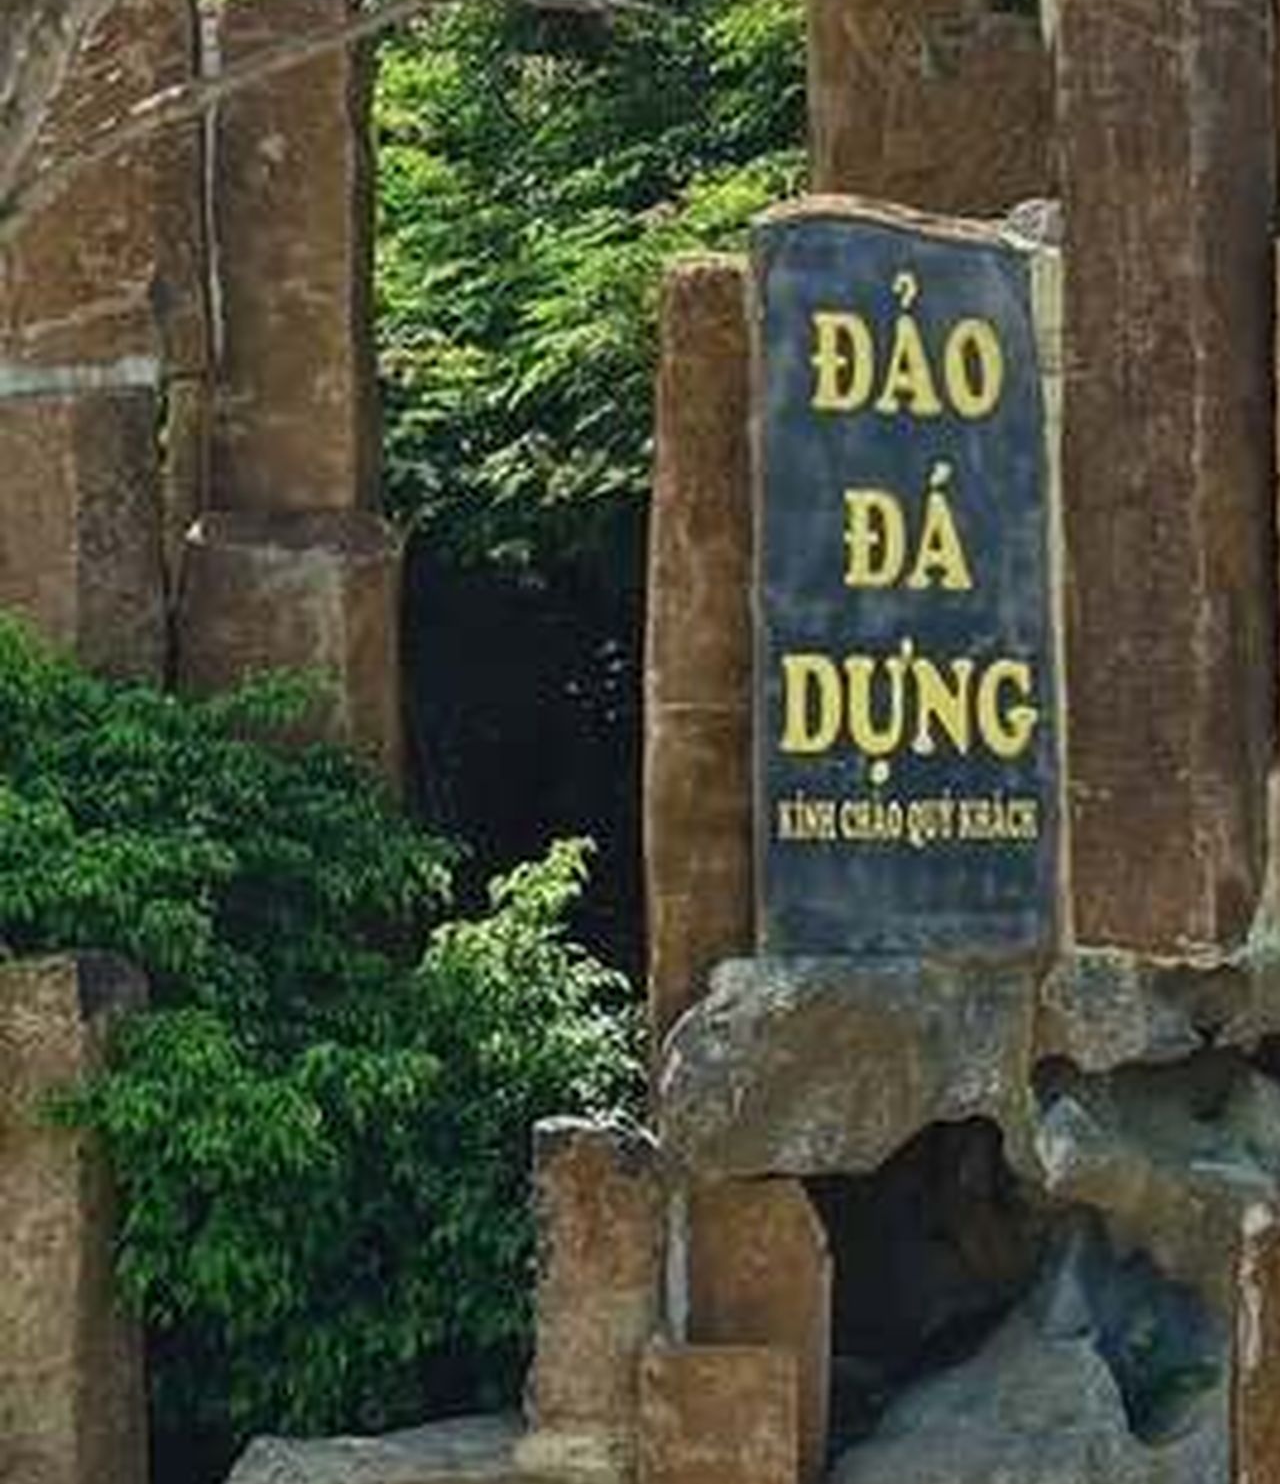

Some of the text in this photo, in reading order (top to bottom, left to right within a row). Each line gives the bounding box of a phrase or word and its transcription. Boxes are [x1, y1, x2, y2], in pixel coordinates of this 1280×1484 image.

[810, 273, 1004, 419] ĐẢO
[844, 461, 972, 589] ĐÁ
[779, 637, 1038, 783] DỰNG
